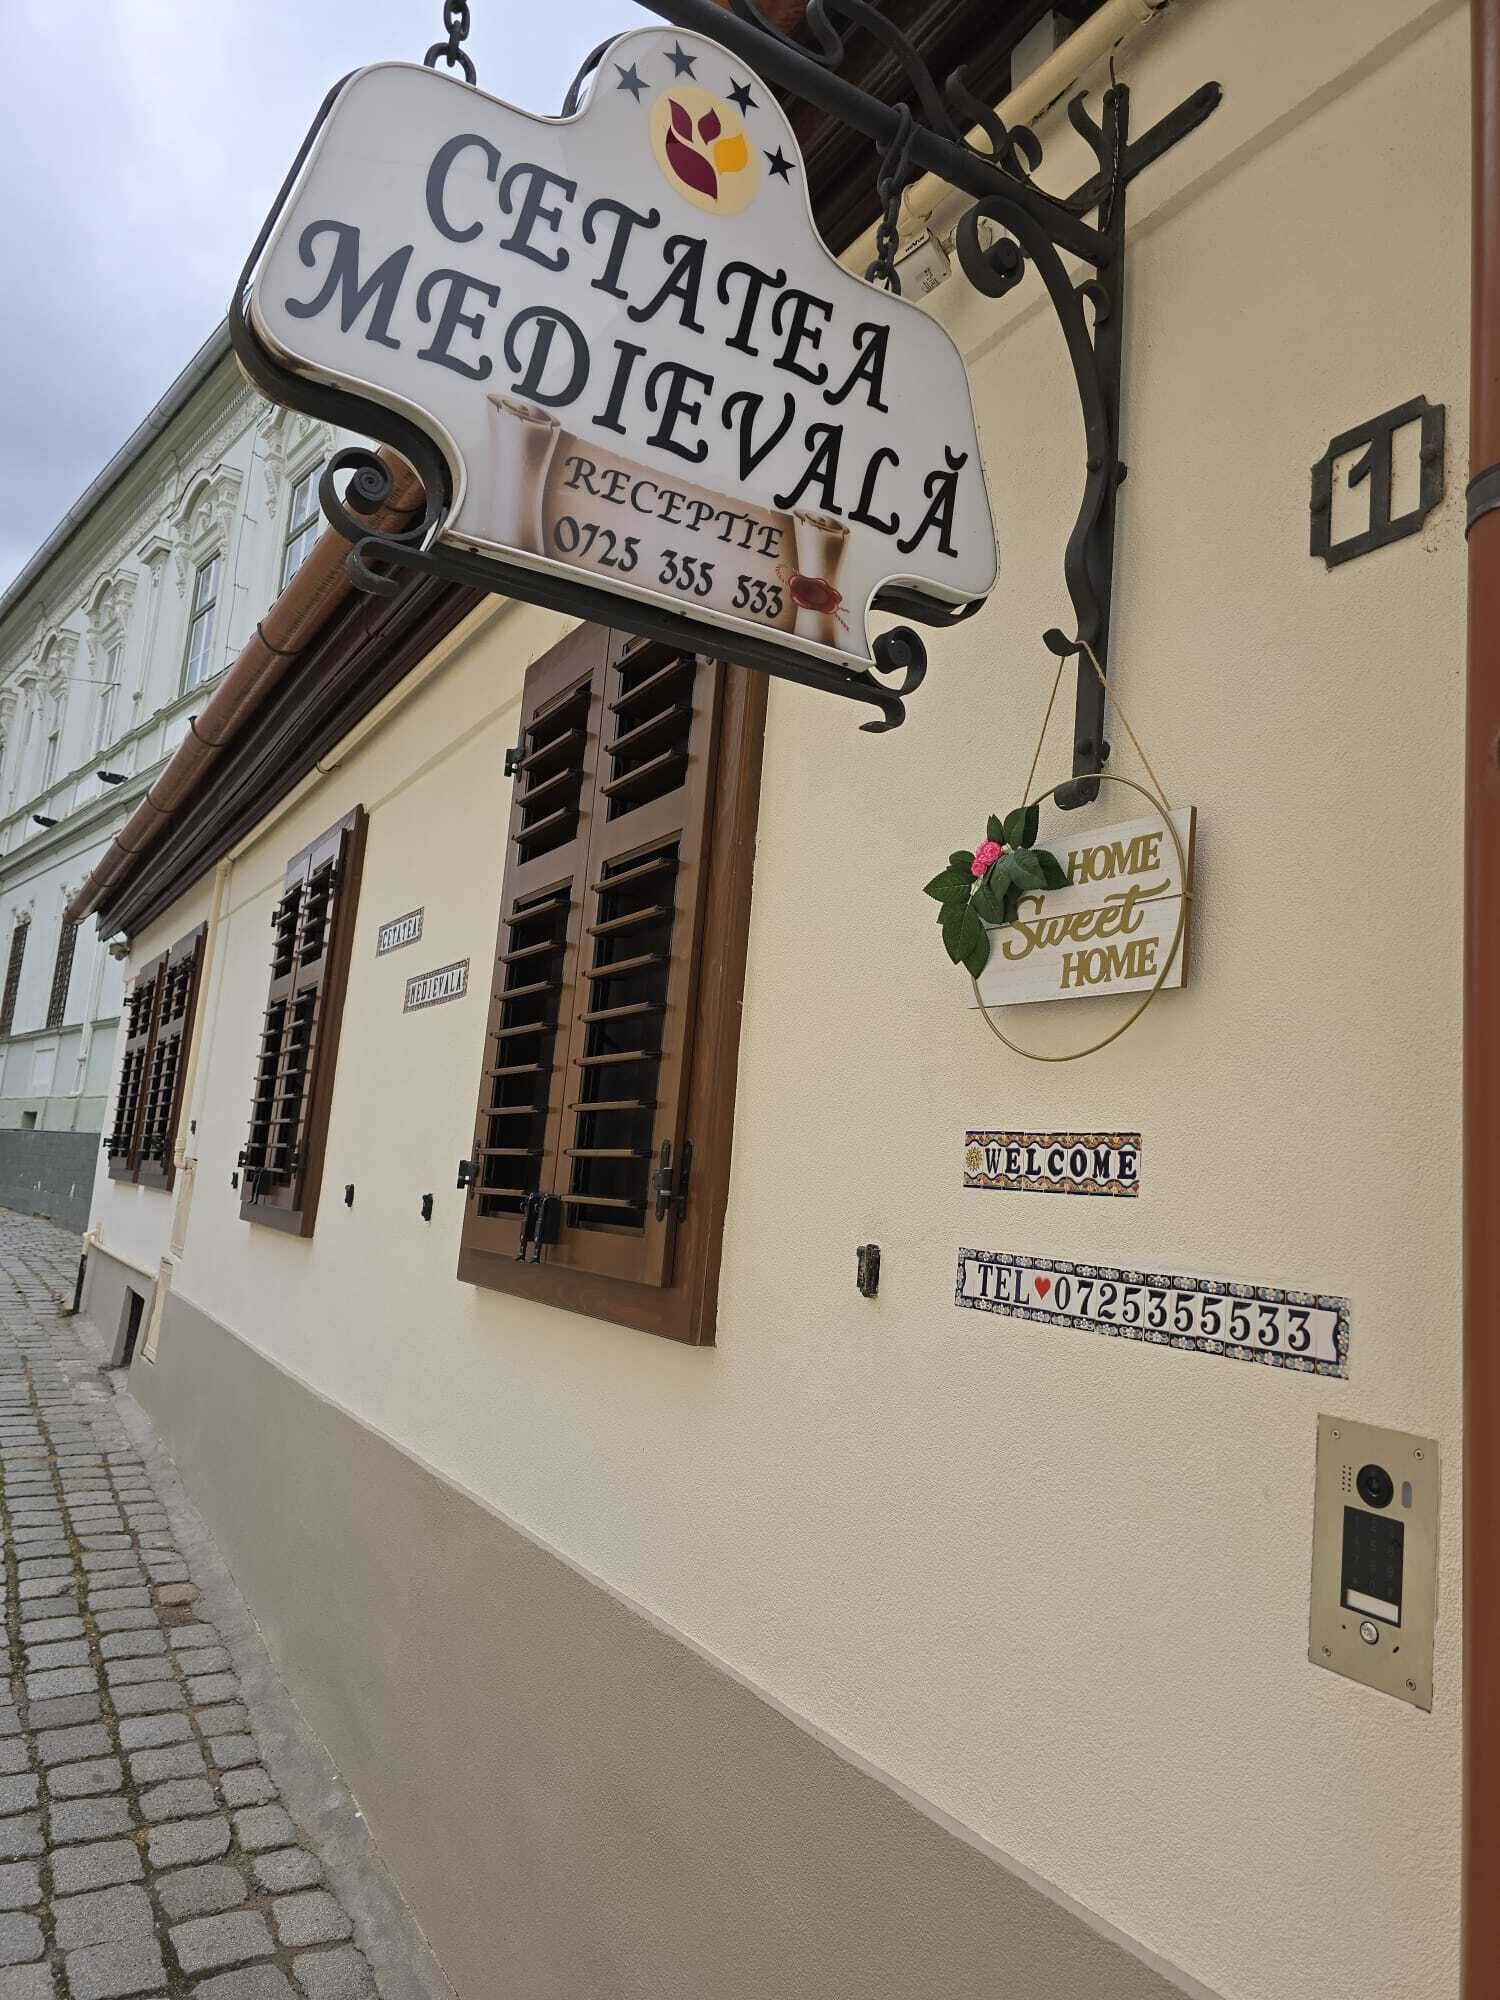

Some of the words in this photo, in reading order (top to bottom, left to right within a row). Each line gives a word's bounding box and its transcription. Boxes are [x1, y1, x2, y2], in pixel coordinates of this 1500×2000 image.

[426, 133, 890, 414] CETATEA
[285, 219, 969, 558] MEDIEVALĂ
[564, 456, 783, 558] RECEPTIE
[554, 515, 641, 572] 0725
[659, 549, 715, 597] 355
[732, 574, 784, 618] 533
[1066, 831, 1163, 885] HOME
[1002, 878, 1171, 960] Sweet
[1060, 937, 1159, 989] HOME
[984, 1146, 1138, 1181] WELCOME
[977, 1263, 1030, 1305] TEL
[1054, 1274, 1312, 1352] 0725355533
